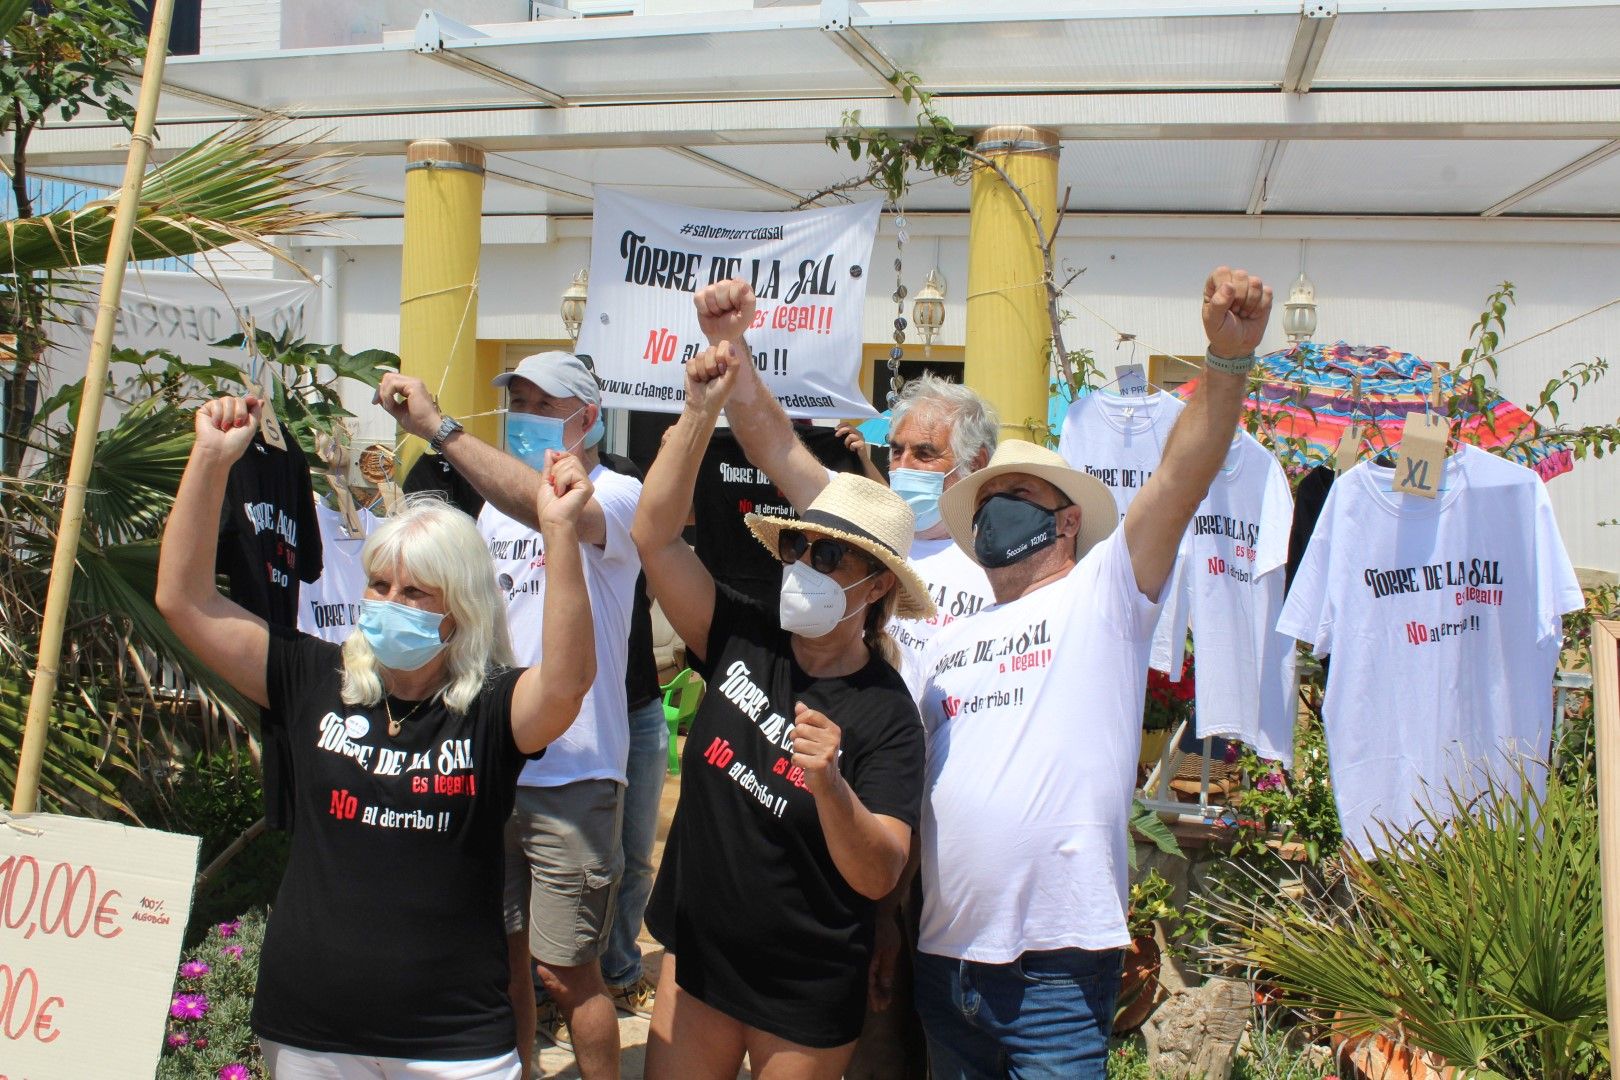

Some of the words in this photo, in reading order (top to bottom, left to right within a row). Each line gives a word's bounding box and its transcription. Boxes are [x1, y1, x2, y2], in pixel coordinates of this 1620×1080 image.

[620, 230, 702, 292] TORRE
[752, 259, 780, 299] LA
[785, 254, 836, 304] SAL
[748, 310, 769, 329] es
[772, 305, 832, 335] legal!!
[720, 462, 753, 484] TORRE
[1122, 469, 1137, 488] DE
[1401, 456, 1432, 490] XL
[763, 504, 788, 515] derribo
[1194, 514, 1223, 536] ORRE
[1233, 519, 1246, 541] LA
[1364, 568, 1420, 598] TORRE
[1423, 565, 1444, 590] DE
[1446, 561, 1466, 586] LA
[1468, 558, 1503, 587] SAL
[1465, 587, 1503, 606] legal!!
[973, 638, 997, 664] DE
[719, 660, 770, 723] TORRE
[758, 712, 786, 745] DE
[373, 748, 407, 775] DE
[406, 749, 431, 774] LA
[438, 739, 474, 775] SAL
[412, 775, 429, 793] es
[728, 761, 743, 781] al
[739, 769, 774, 809] derribo
[773, 796, 788, 818] !!
[362, 806, 377, 826] al
[379, 807, 434, 830] derribo
[437, 812, 451, 832] !!
